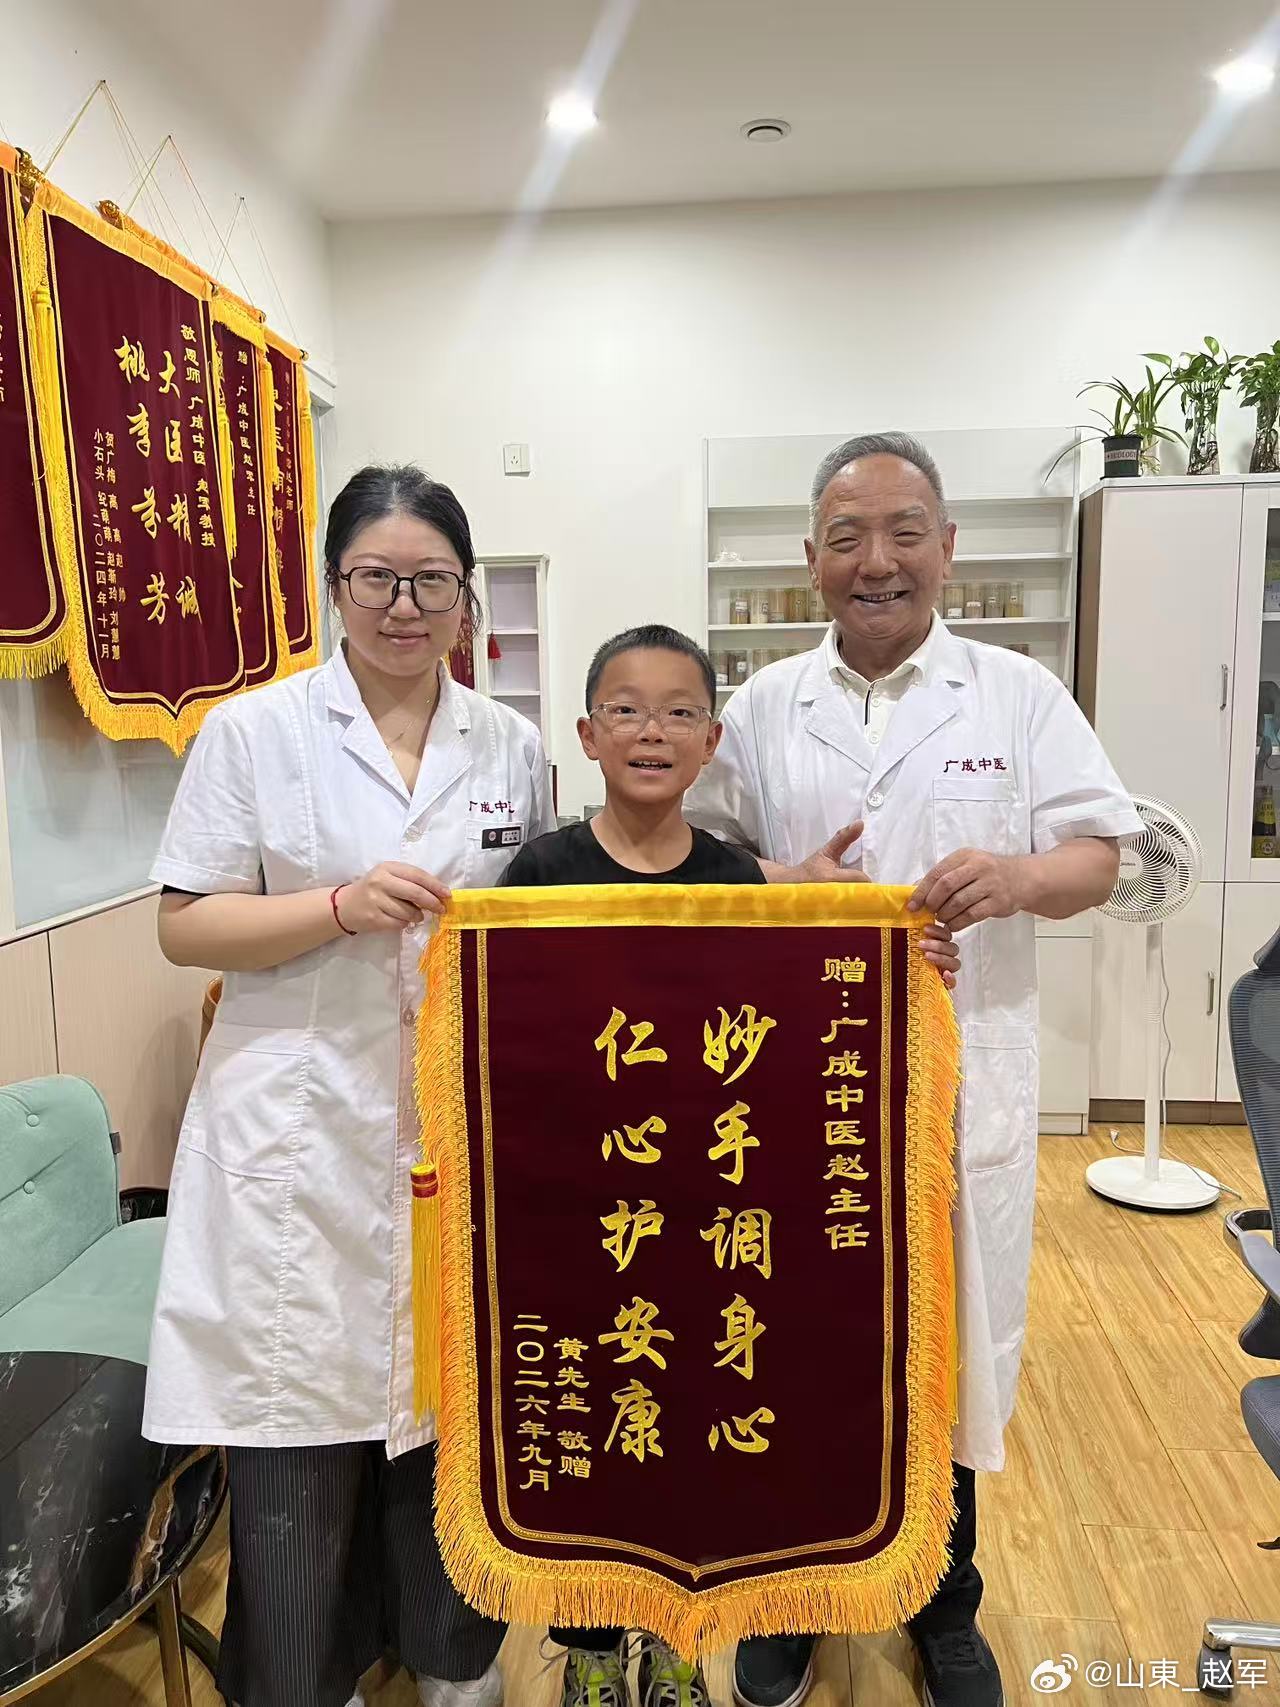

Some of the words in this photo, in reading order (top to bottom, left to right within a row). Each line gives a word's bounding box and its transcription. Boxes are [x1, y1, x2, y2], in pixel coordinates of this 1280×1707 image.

[159, 350, 203, 625] 大医精诚
[187, 395, 206, 466] 广成中医
[943, 757, 1007, 773] 广成中医
[821, 957, 870, 1250] 赠：广成中医赵主任
[594, 1007, 675, 1464] 仁心护安康
[700, 1005, 777, 1453] 妙手调身心
[513, 1314, 552, 1492] 二〇二六年九月
[553, 1337, 592, 1413] 黄先生
[556, 1430, 592, 1479] 敬赠
